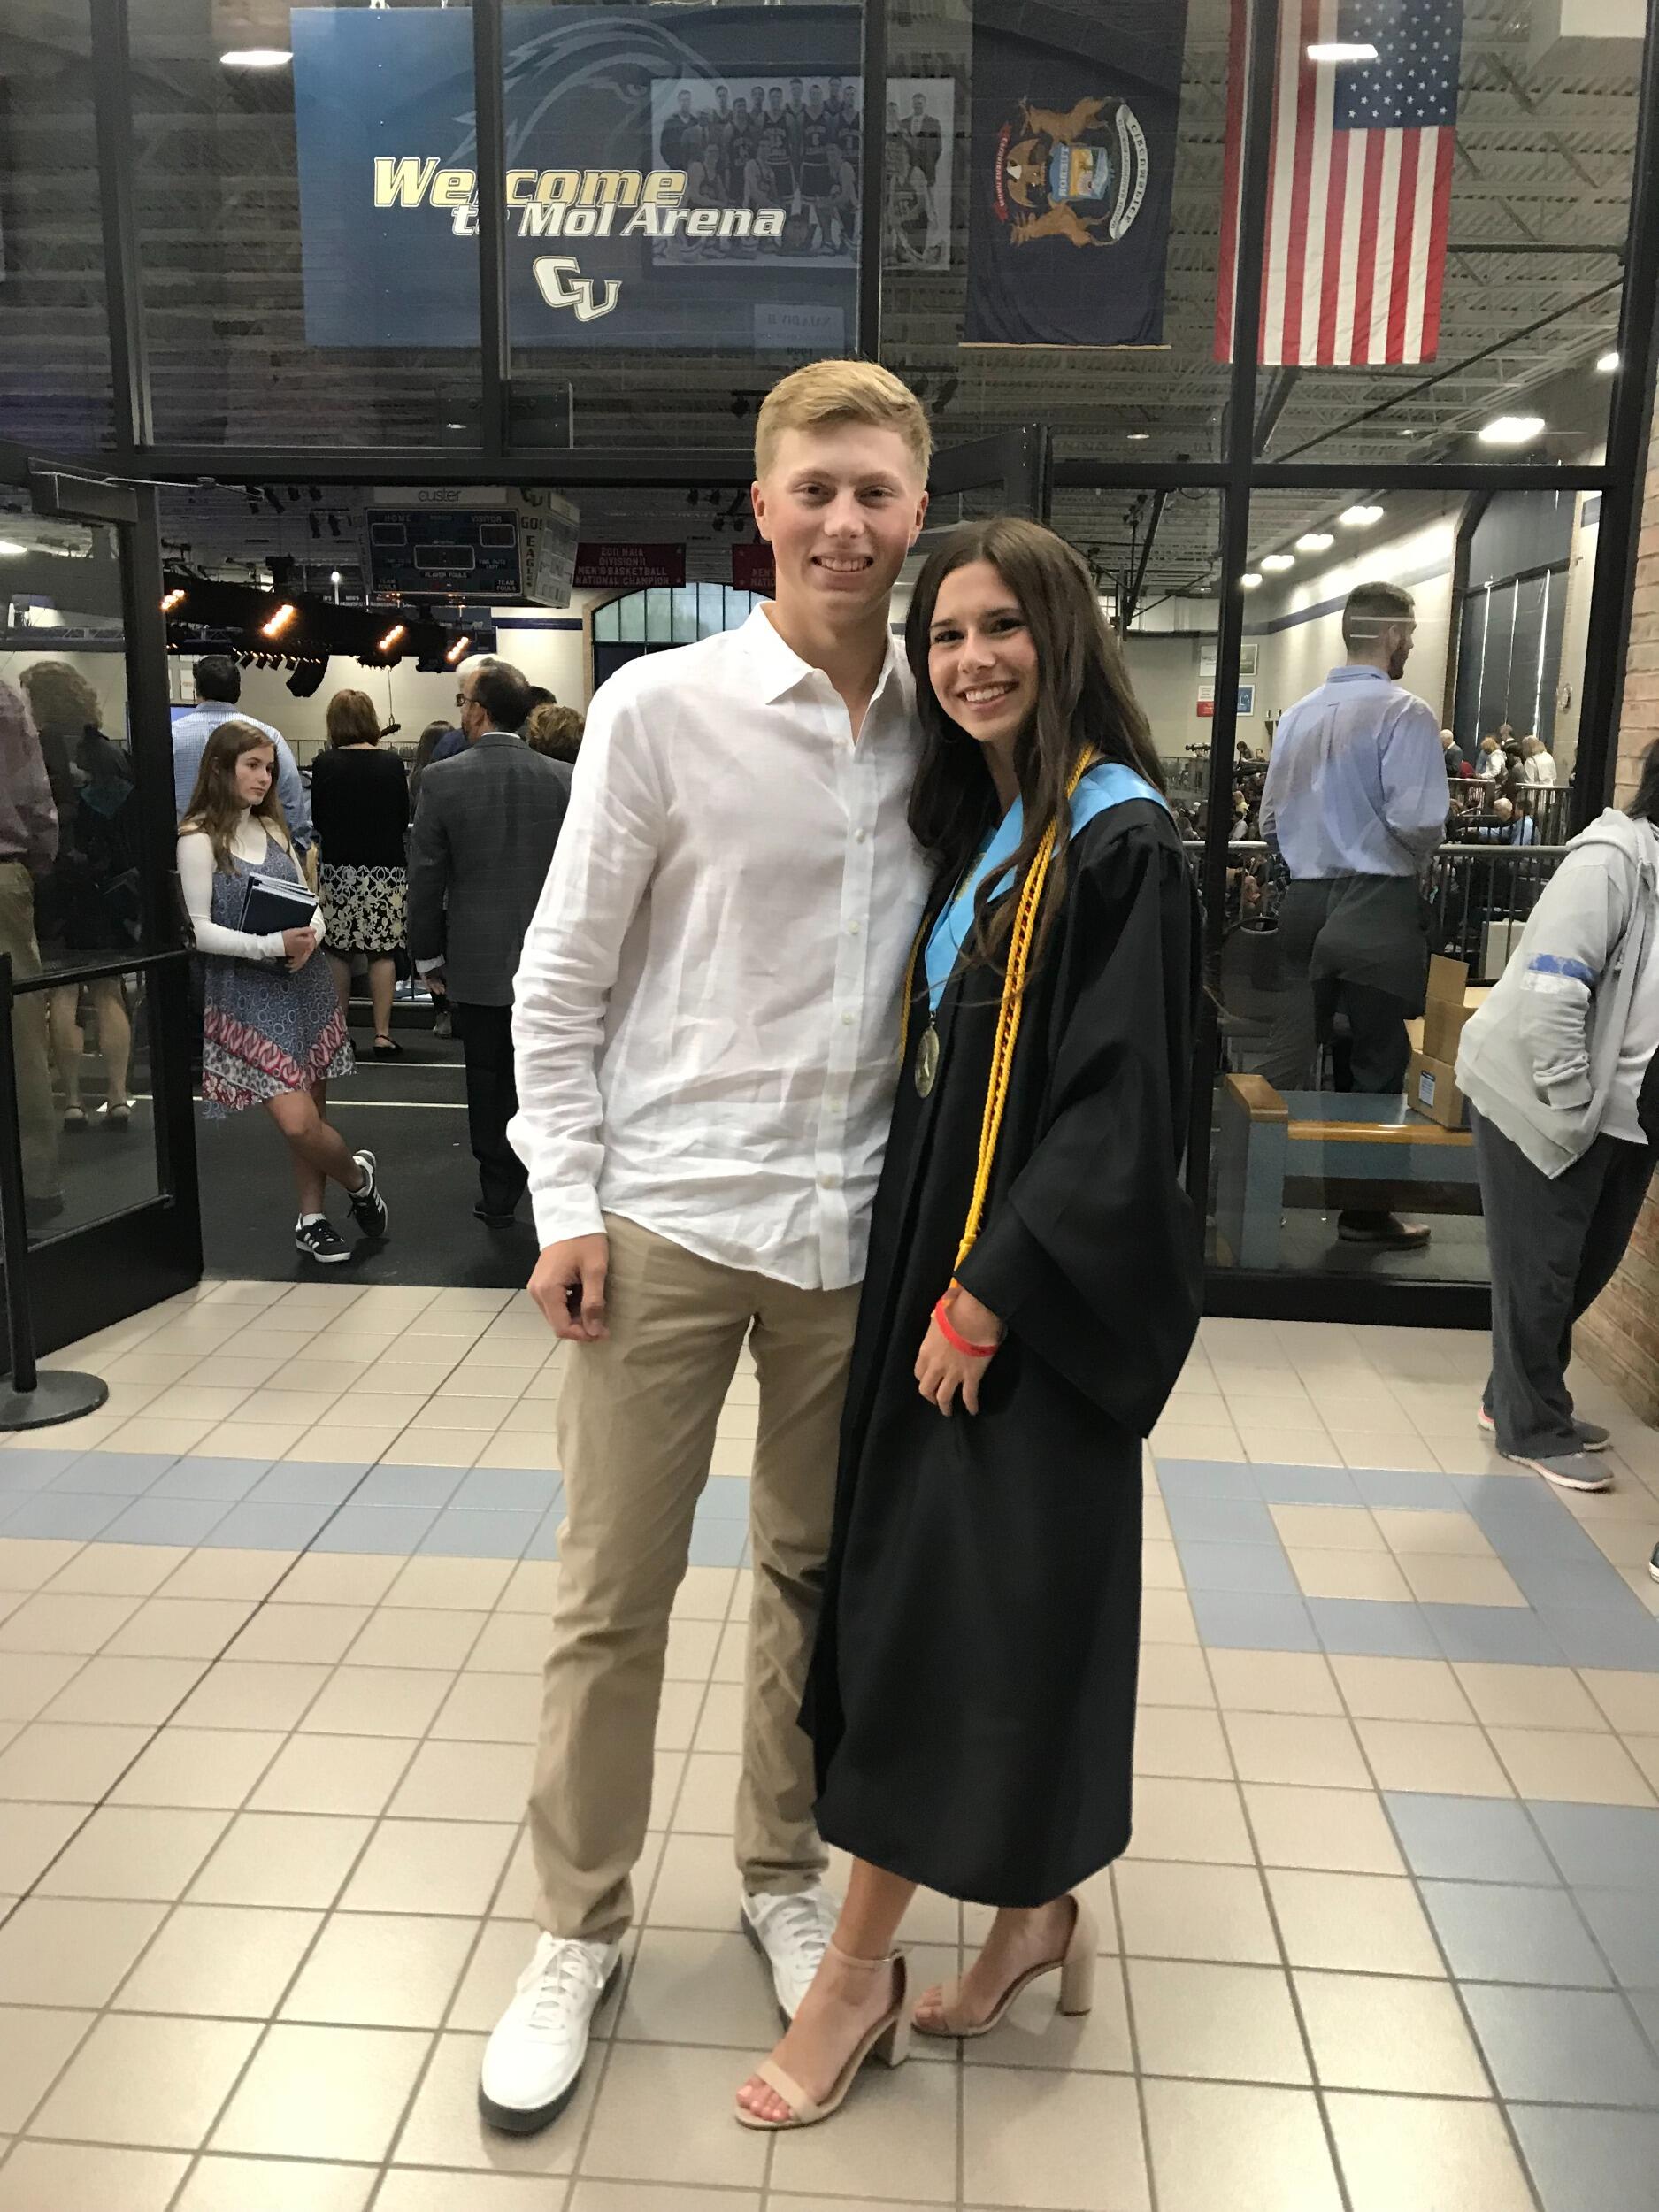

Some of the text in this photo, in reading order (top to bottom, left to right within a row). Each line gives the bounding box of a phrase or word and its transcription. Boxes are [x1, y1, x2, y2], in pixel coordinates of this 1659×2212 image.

[373, 157, 688, 208] Wecome
[450, 201, 786, 236] t Mol Arena
[533, 255, 622, 322] CU
[418, 488, 461, 502] custer
[520, 517, 542, 530] GO!
[598, 557, 638, 566] DIVISION
[607, 567, 667, 576] BASKETBALL
[575, 575, 670, 586] NATIONAL CHAMPION
